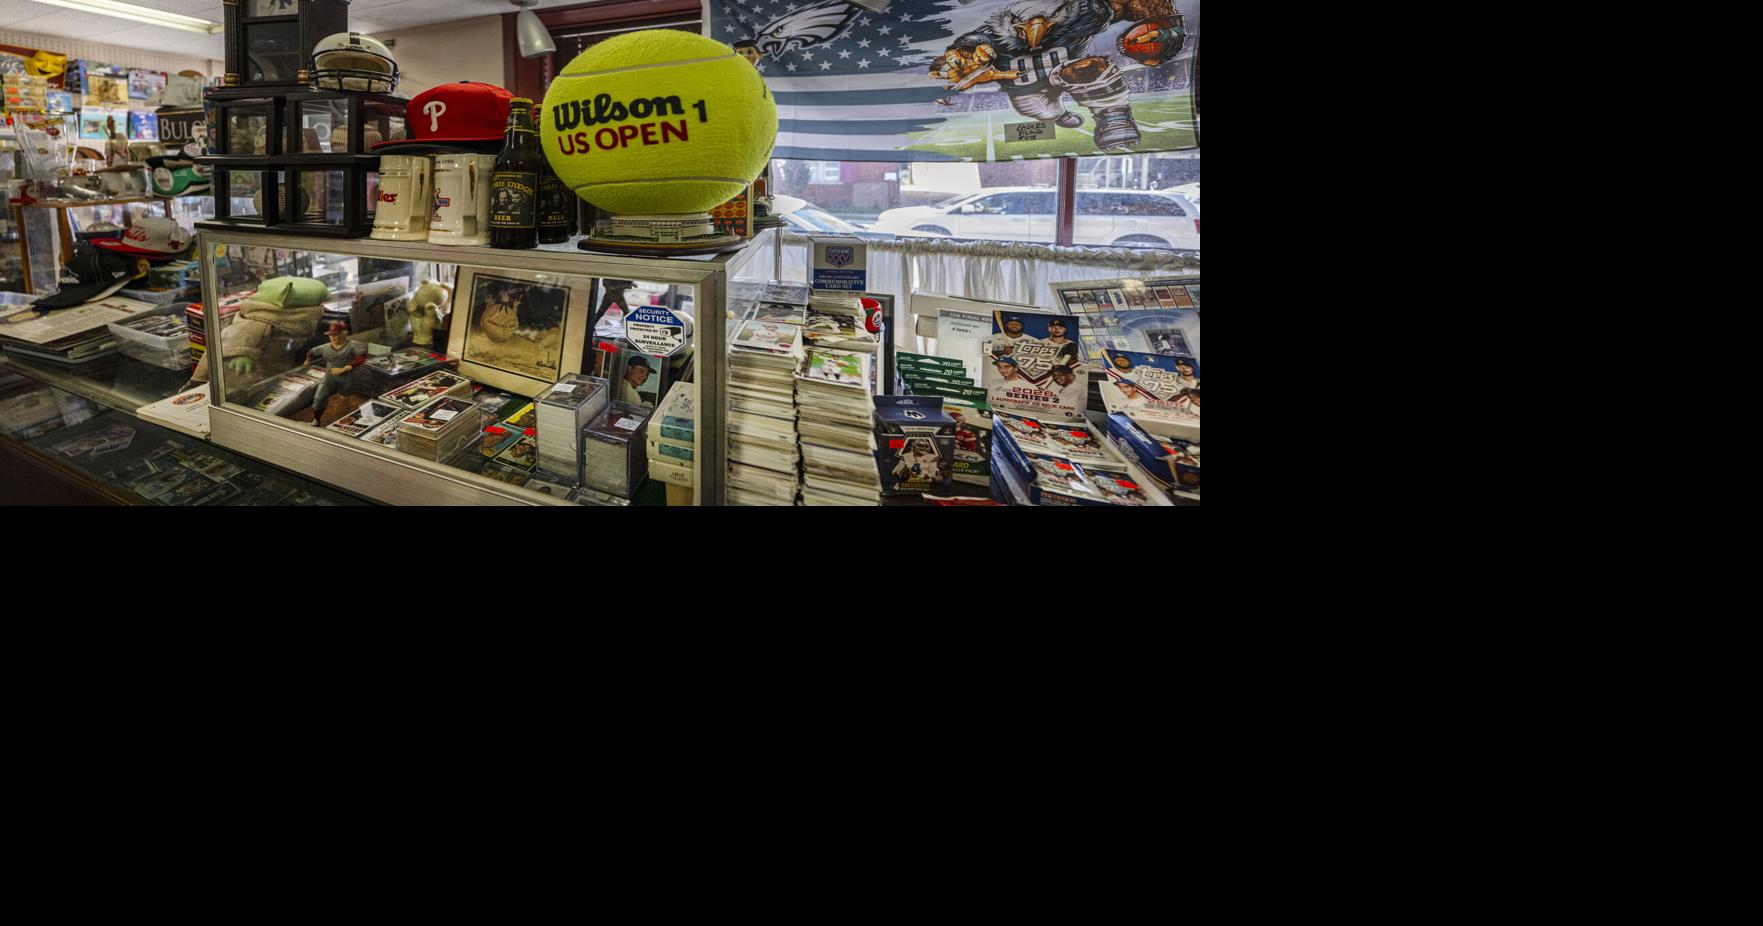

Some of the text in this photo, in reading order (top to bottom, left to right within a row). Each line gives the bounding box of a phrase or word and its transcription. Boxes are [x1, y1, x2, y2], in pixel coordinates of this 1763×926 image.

[423, 101, 447, 132] P
[553, 93, 708, 131] Wilson 1
[557, 119, 689, 155] US OPEN
[506, 181, 534, 196] STOOGES
[635, 314, 674, 324] NOTICE
[638, 308, 670, 316] SECURITY
[635, 339, 676, 348] SURVEILLANCE
[1018, 356, 1052, 371] 75
[1142, 380, 1177, 394] 75
[996, 397, 1029, 405] AUTOGRAPH
[1006, 391, 1049, 402] SERIES
